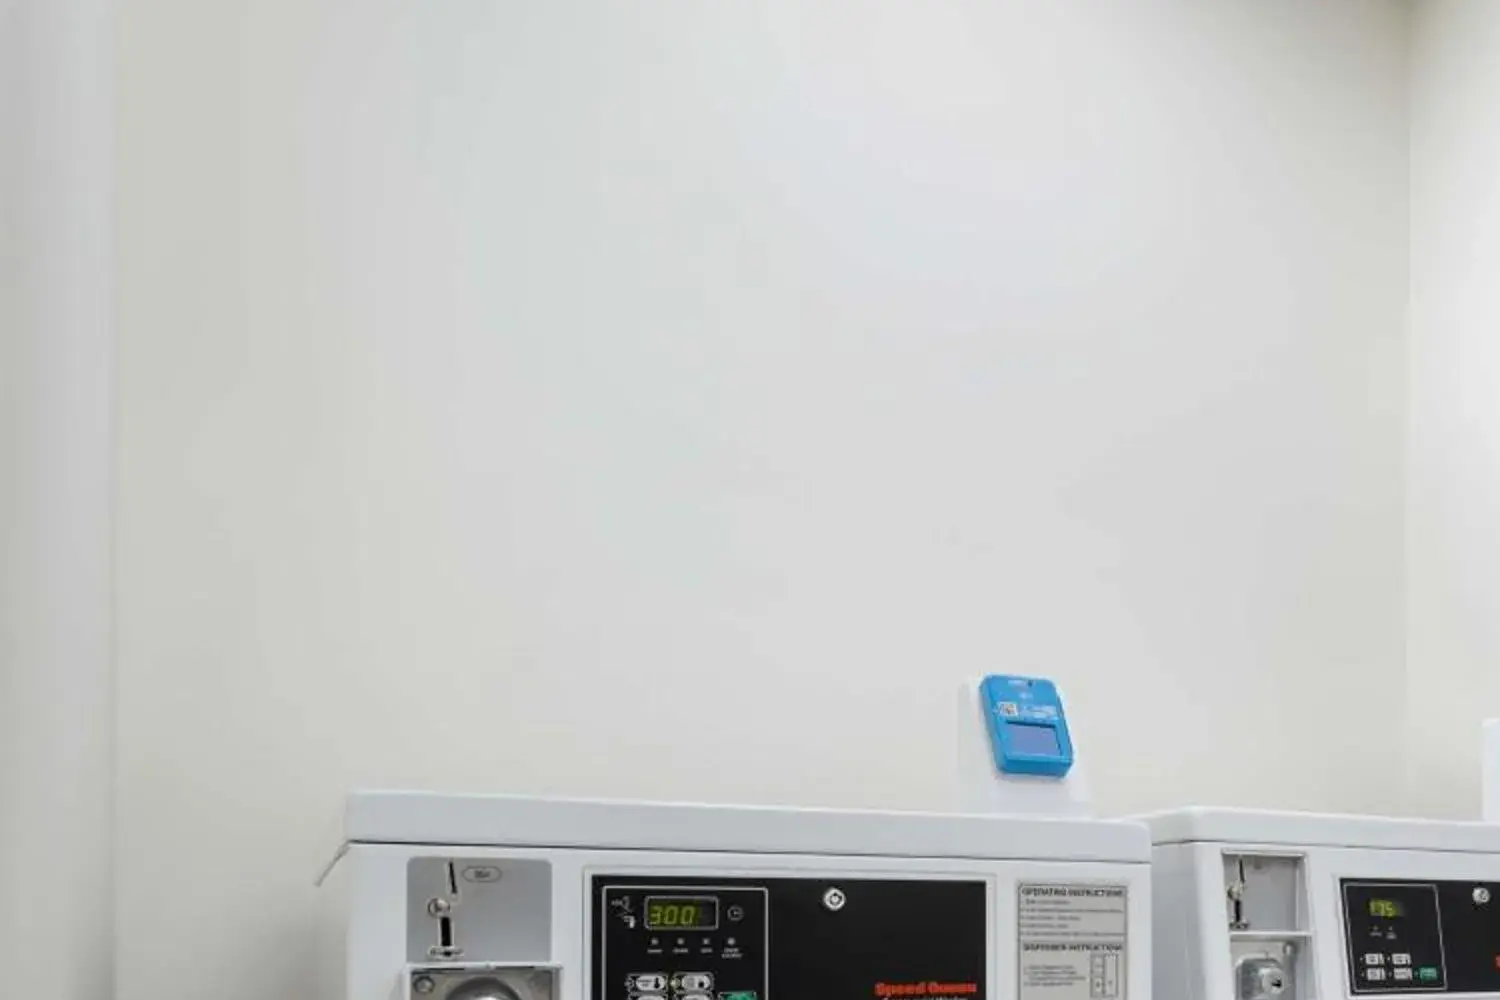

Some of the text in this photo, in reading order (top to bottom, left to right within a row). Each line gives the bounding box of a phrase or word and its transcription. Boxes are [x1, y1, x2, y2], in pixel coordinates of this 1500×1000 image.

[1021, 887, 1123, 897] OPERATING INSTRUCTIONS
[649, 905, 695, 925] 300
[875, 982, 977, 997] Speed Queen
